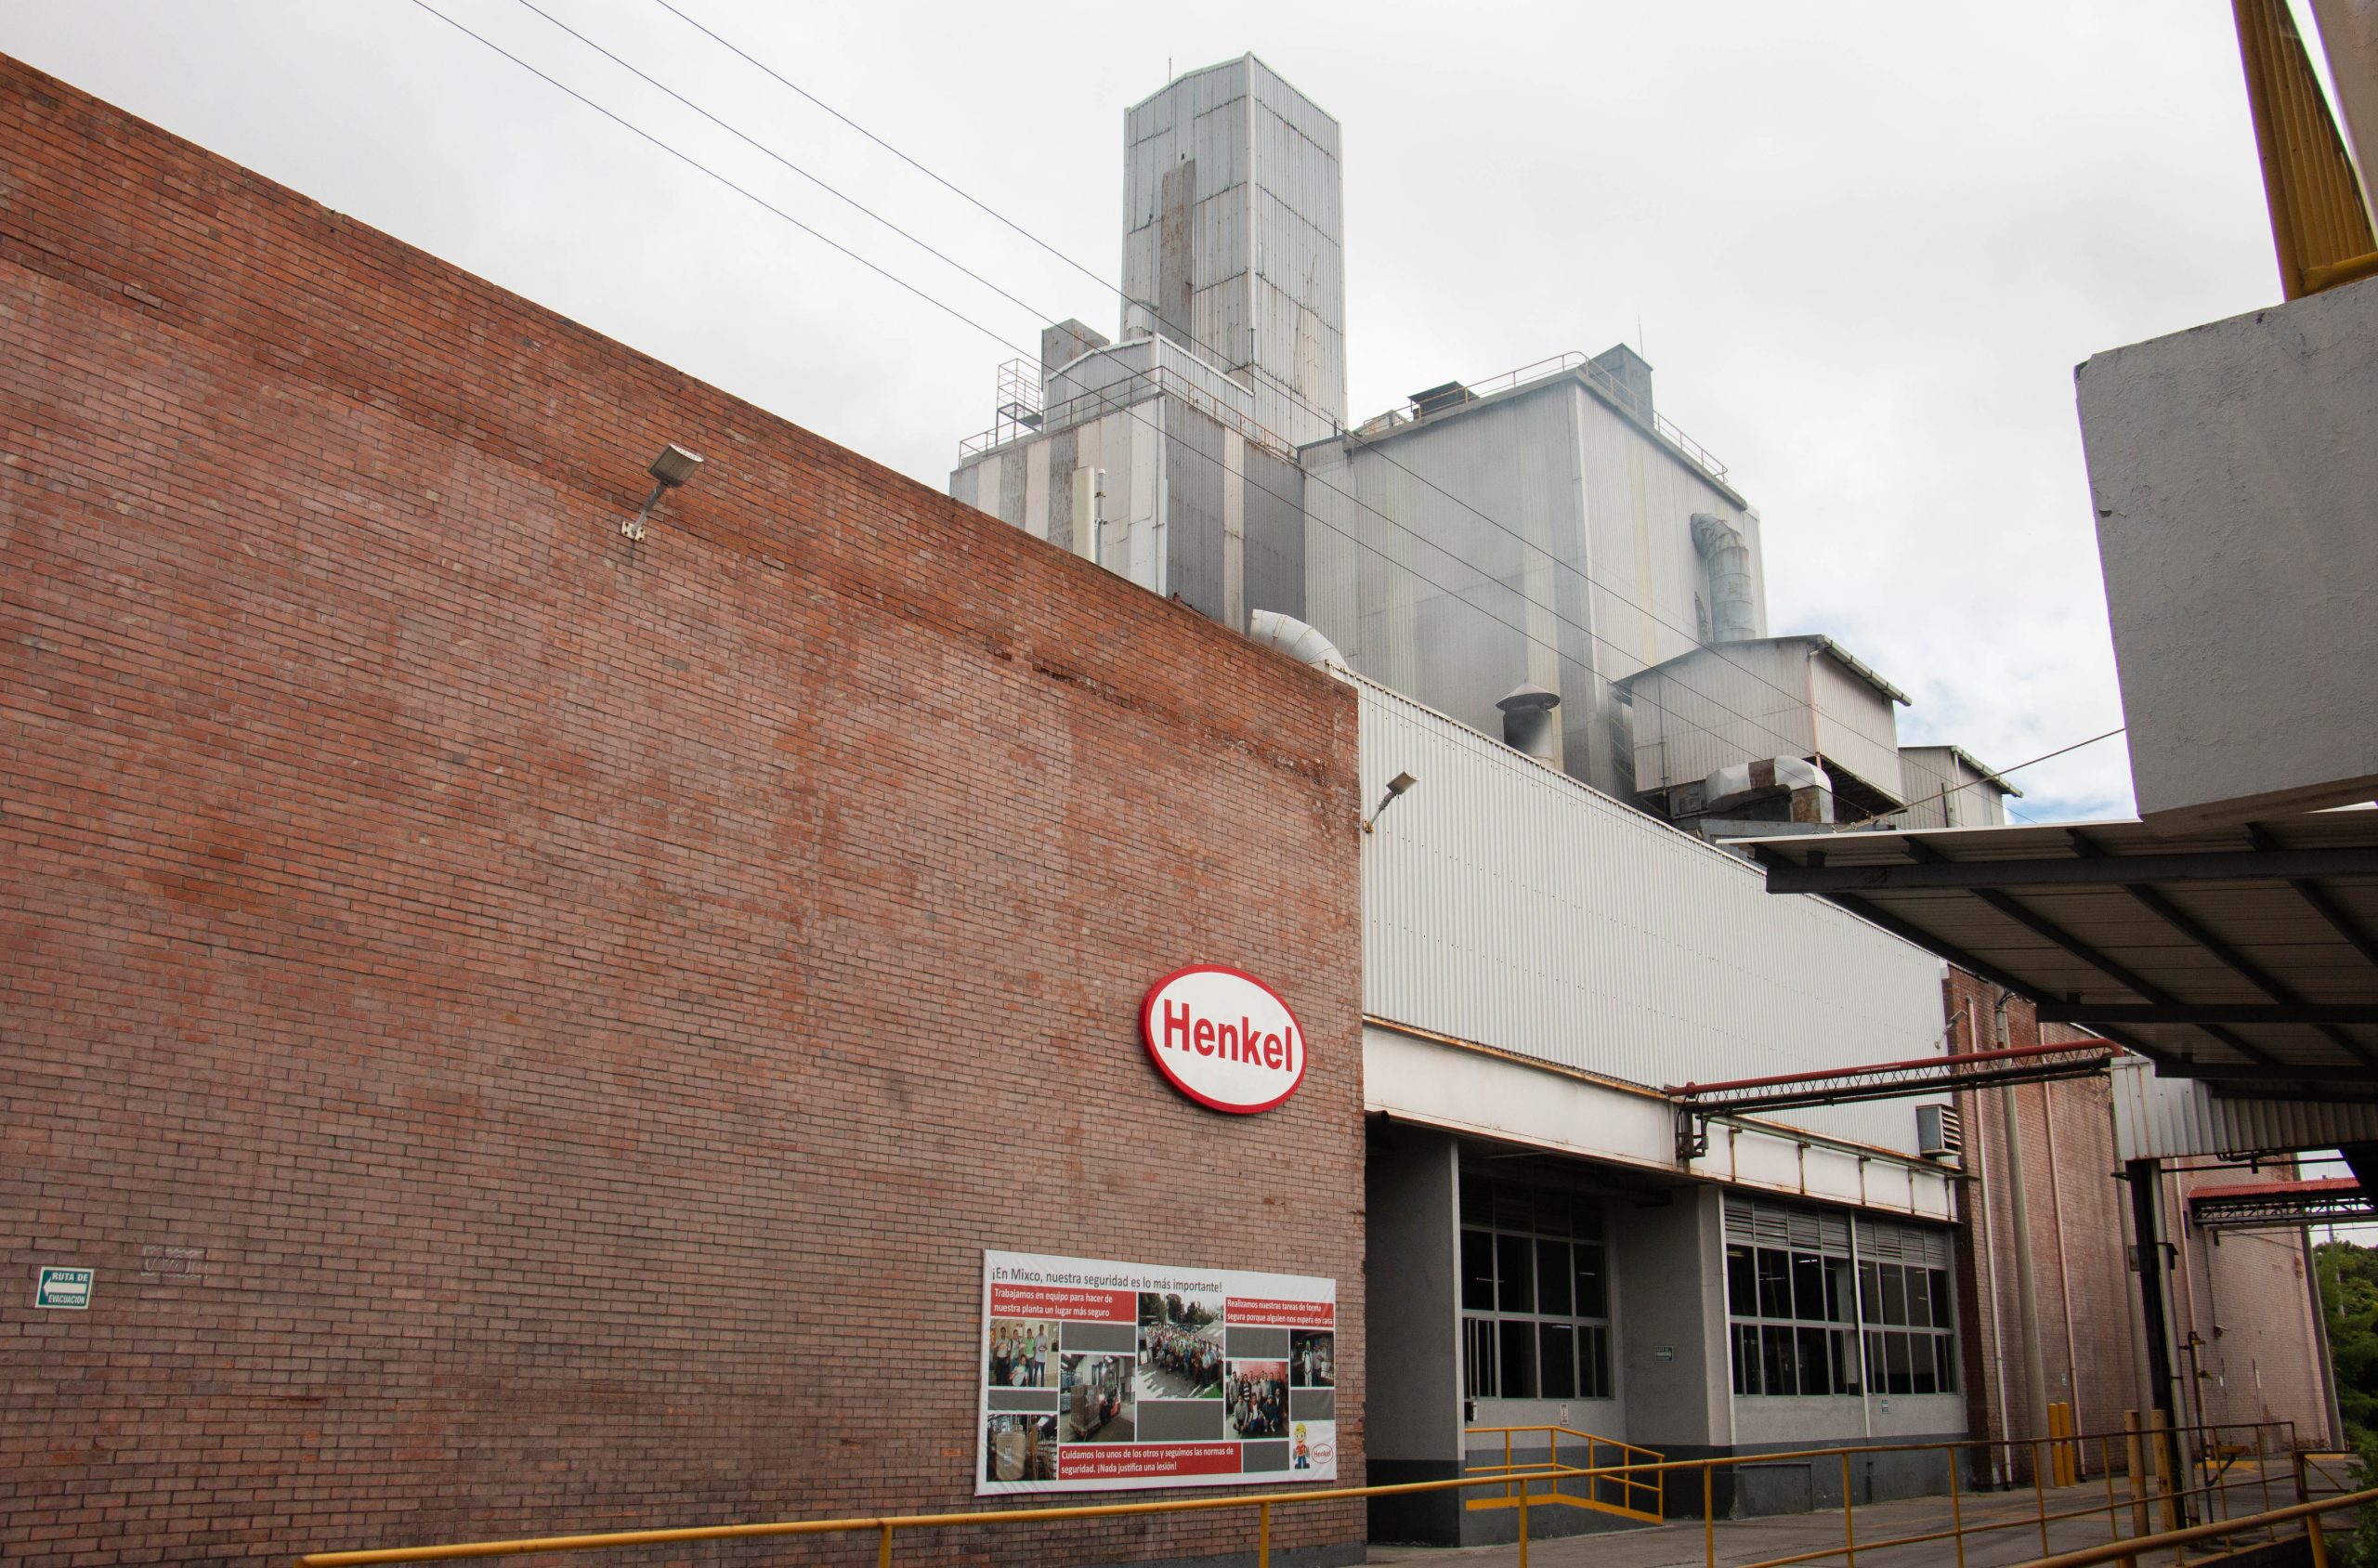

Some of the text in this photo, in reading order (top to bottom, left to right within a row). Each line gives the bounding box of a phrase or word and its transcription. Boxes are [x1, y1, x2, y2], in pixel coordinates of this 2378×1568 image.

[1163, 999, 1293, 1073] Henkel
[52, 1272, 89, 1282] RUTA DE
[992, 1267, 1222, 1293] ¡En Mixco, nuestra seguridad es lo más importante!
[48, 1294, 85, 1304] EVACUACION
[994, 1287, 1113, 1303] Trabajamos en equipo para hacer de
[994, 1303, 1021, 1313] nuestra
[1022, 1303, 1043, 1314] planta
[1054, 1304, 1072, 1316] lugar
[1073, 1306, 1087, 1316] más
[1087, 1309, 1110, 1317] seguro
[1227, 1299, 1258, 1309] Realizamos
[1259, 1301, 1281, 1310] nuestras
[1282, 1302, 1299, 1311] tareas
[1306, 1303, 1321, 1312] forma
[1227, 1313, 1246, 1322] segura
[1247, 1314, 1266, 1323] porque
[1267, 1313, 1286, 1324] alguien
[1297, 1316, 1313, 1325] espera
[1061, 1450, 1094, 1459] Cuidamos
[1095, 1449, 1105, 1458] los
[1122, 1448, 1131, 1458] de
[1132, 1448, 1142, 1458] los
[1143, 1449, 1159, 1457] otros
[1160, 1450, 1164, 1459] y
[1165, 1447, 1194, 1458] seguimos
[1194, 1446, 1203, 1457] las
[1225, 1445, 1235, 1456] de
[1061, 1464, 1096, 1475] seguridad.
[1097, 1462, 1117, 1474] ¡Nada
[1117, 1462, 1143, 1474] justifica
[1156, 1460, 1177, 1471] lesión!
